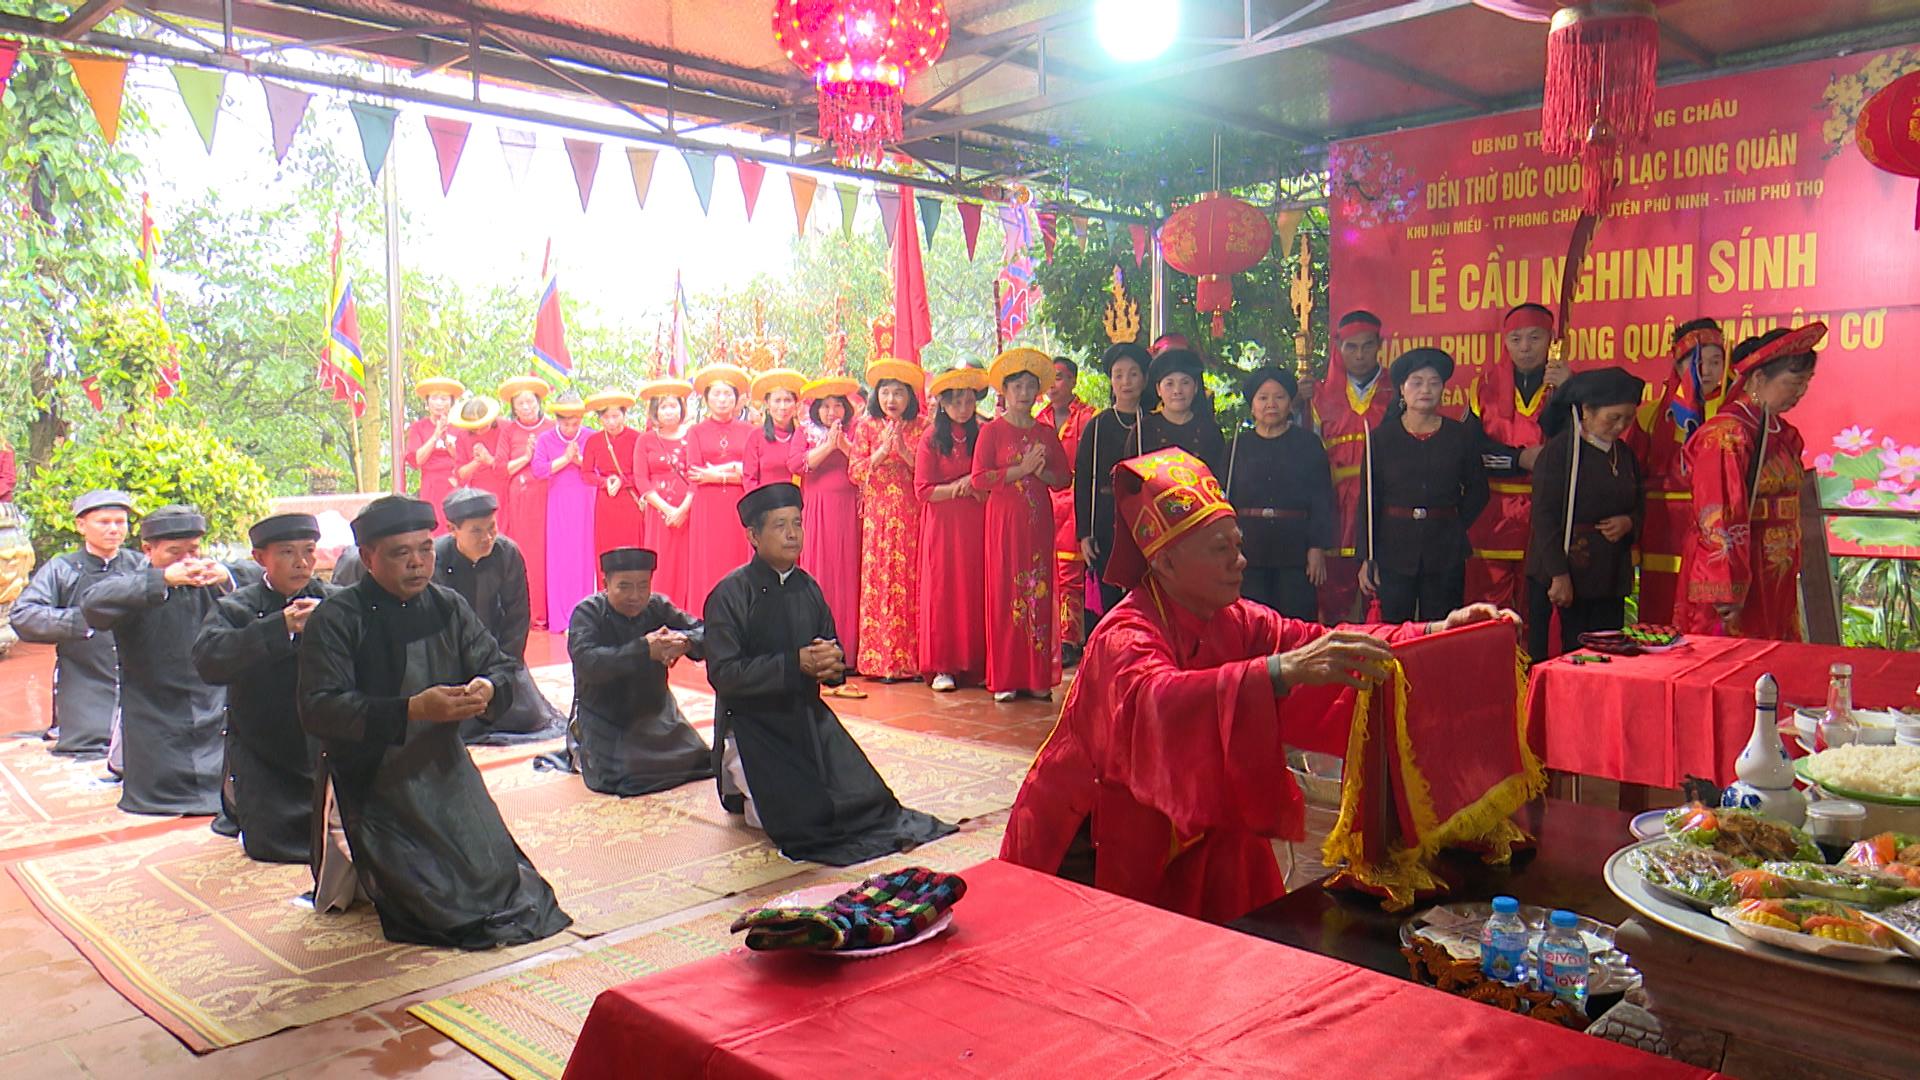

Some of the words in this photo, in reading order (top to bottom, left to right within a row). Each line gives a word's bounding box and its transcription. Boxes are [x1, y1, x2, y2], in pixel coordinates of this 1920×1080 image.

[1472, 134, 1518, 156] UBND
[1523, 130, 1544, 148] TH
[1682, 98, 1738, 124] CHÂU
[1426, 170, 1460, 211] ĐỀN
[1464, 166, 1499, 206] THỜ
[1502, 162, 1538, 201] ĐỨC
[1544, 152, 1587, 198] QUỐ
[1629, 150, 1667, 190] LẠC
[1673, 142, 1728, 180] LONG
[1735, 129, 1798, 175] QUÂN
[1407, 224, 1428, 240] KHU
[1453, 214, 1482, 235] MIẾU
[1493, 216, 1505, 230] TT
[1508, 211, 1549, 229] PHONG
[1607, 198, 1640, 219] UYỆN
[1675, 192, 1709, 210] NINH
[1410, 249, 1447, 314] LỄ
[1458, 245, 1529, 311] CẦU
[1542, 243, 1694, 305] NGHINH
[1707, 226, 1818, 293] SÍNH
[1441, 332, 1486, 372] PHỤ
[1568, 326, 1615, 361] ONG
[1624, 315, 1676, 362] QUÂ
[1840, 308, 1887, 351] CƠ
[1441, 384, 1471, 406] GÀY
